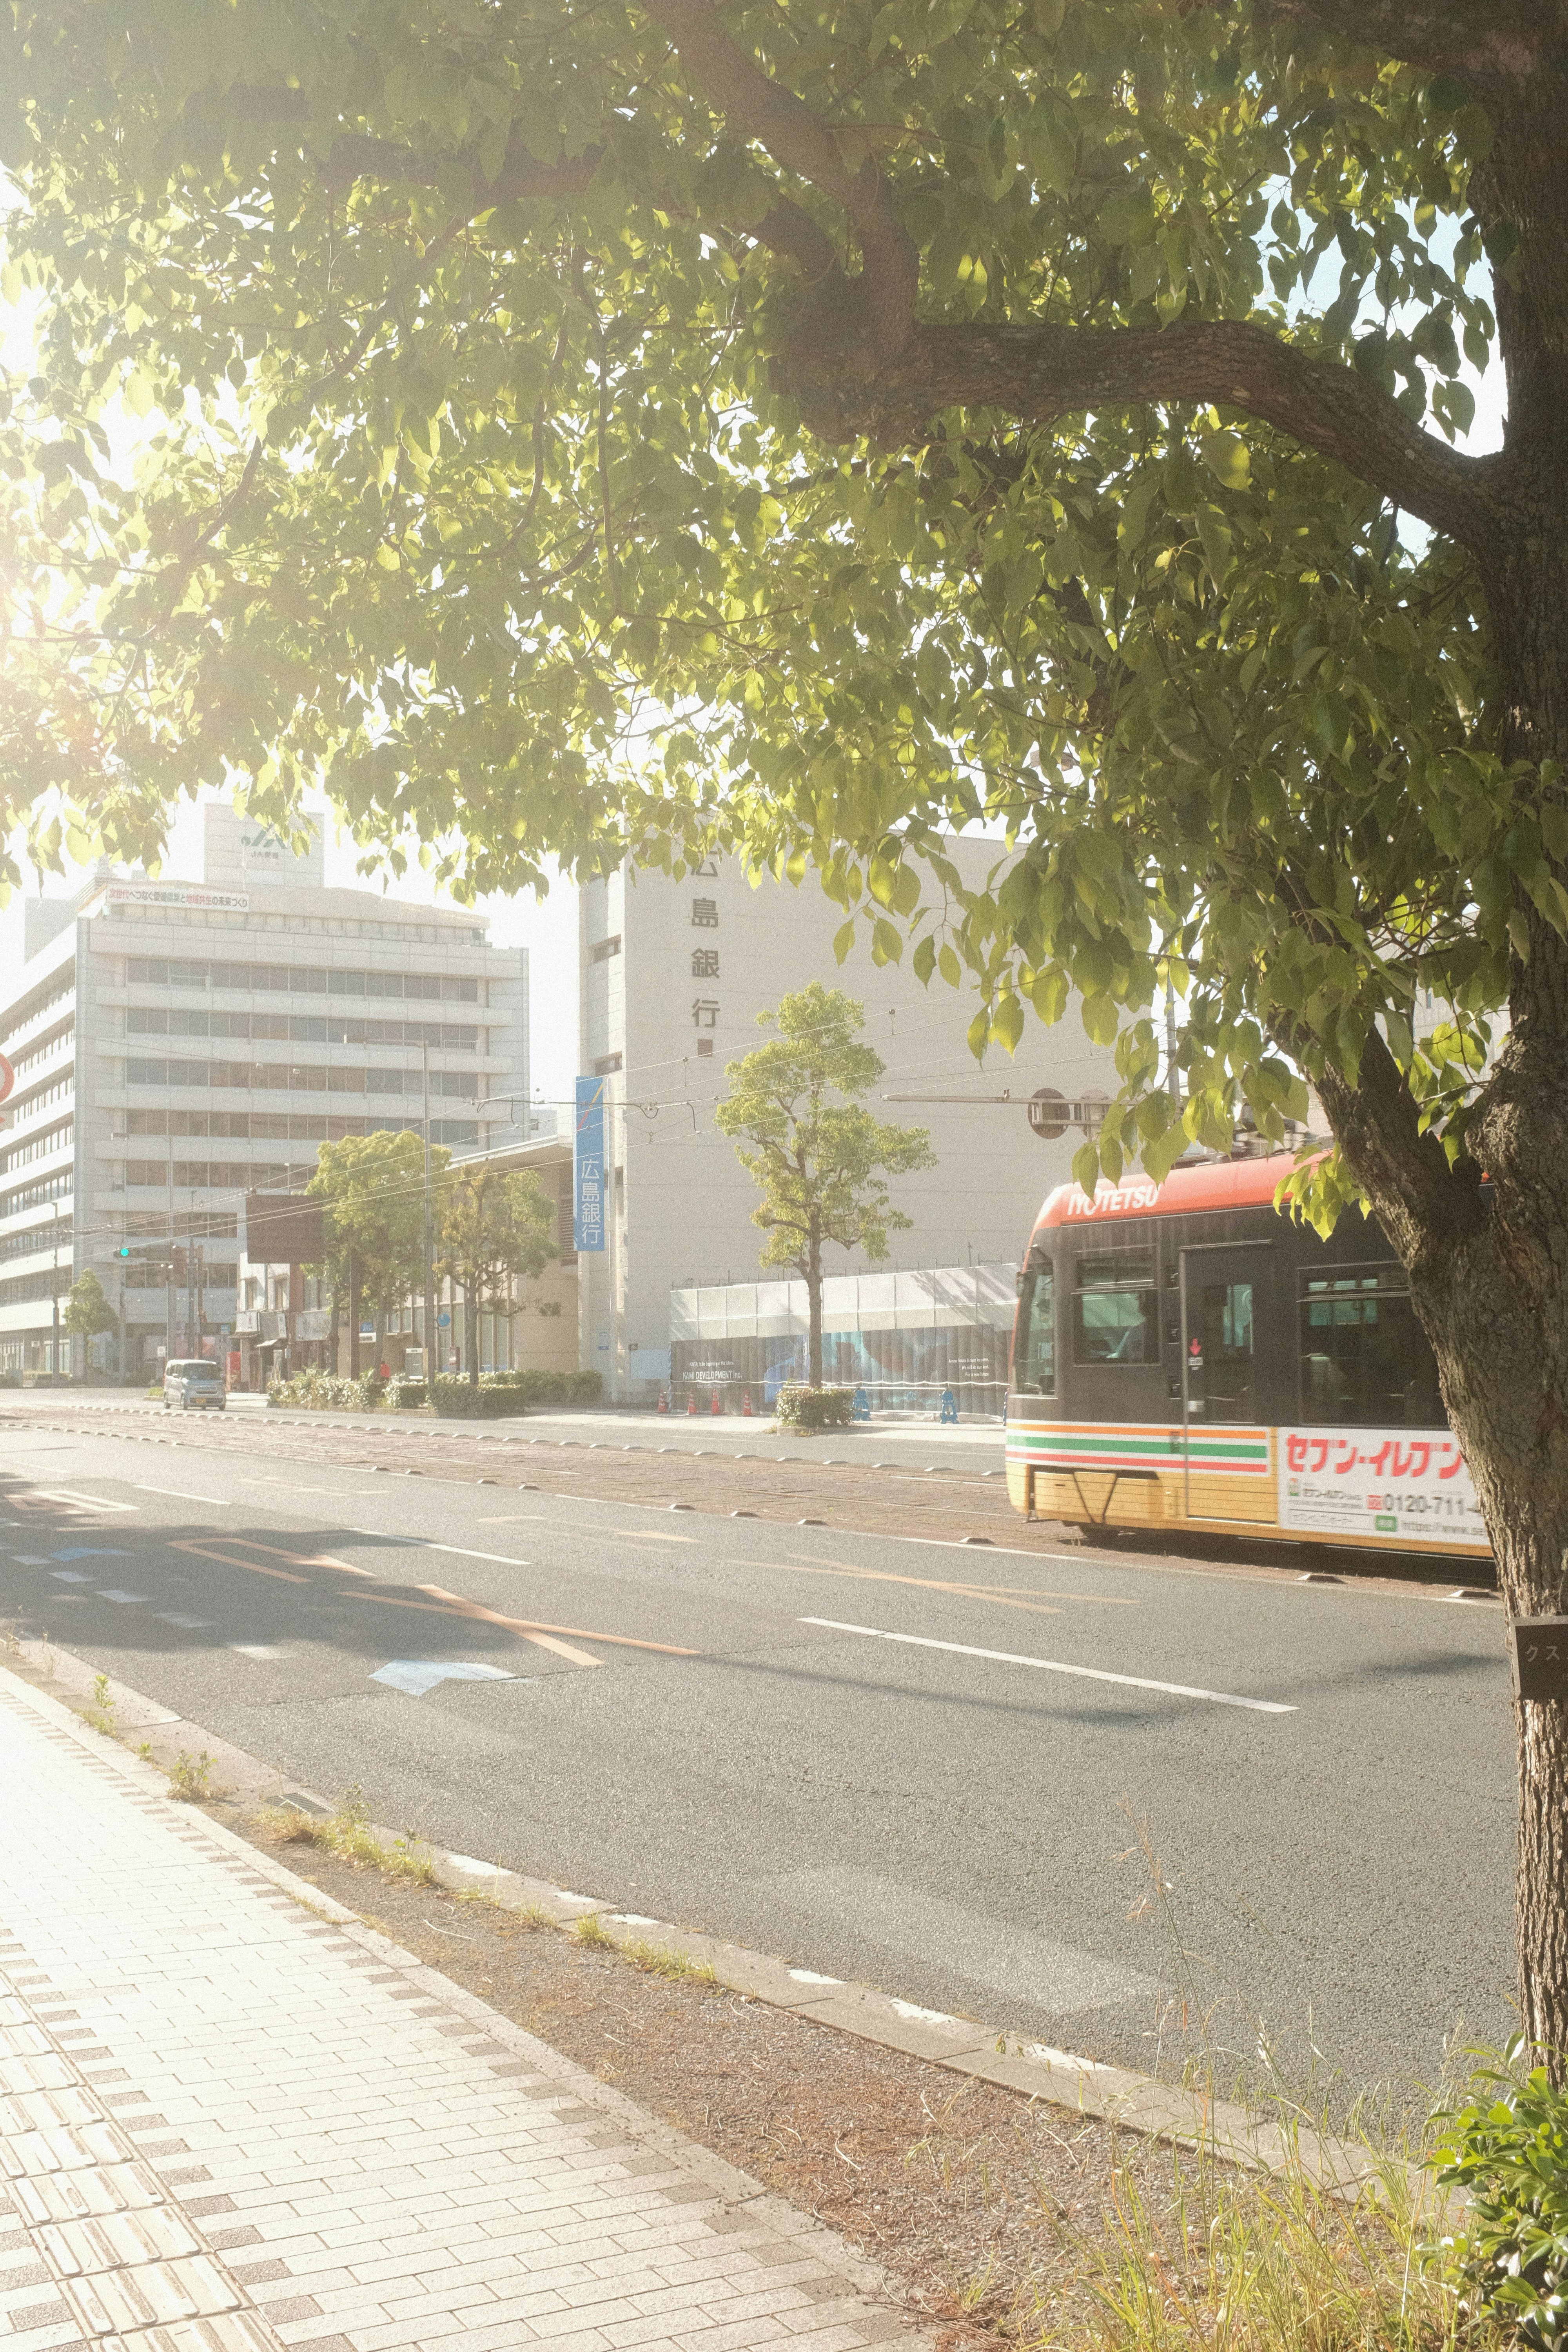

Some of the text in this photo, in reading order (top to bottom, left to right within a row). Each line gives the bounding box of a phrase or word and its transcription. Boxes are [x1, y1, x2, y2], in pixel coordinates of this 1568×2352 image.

[581, 1159, 601, 1244] 広島銀行
[1067, 1184, 1161, 1216] IYOTETSU
[683, 1370, 742, 1380] KAMI DEVELOPMENT Inc.
[1526, 1644, 1568, 1662] クス
